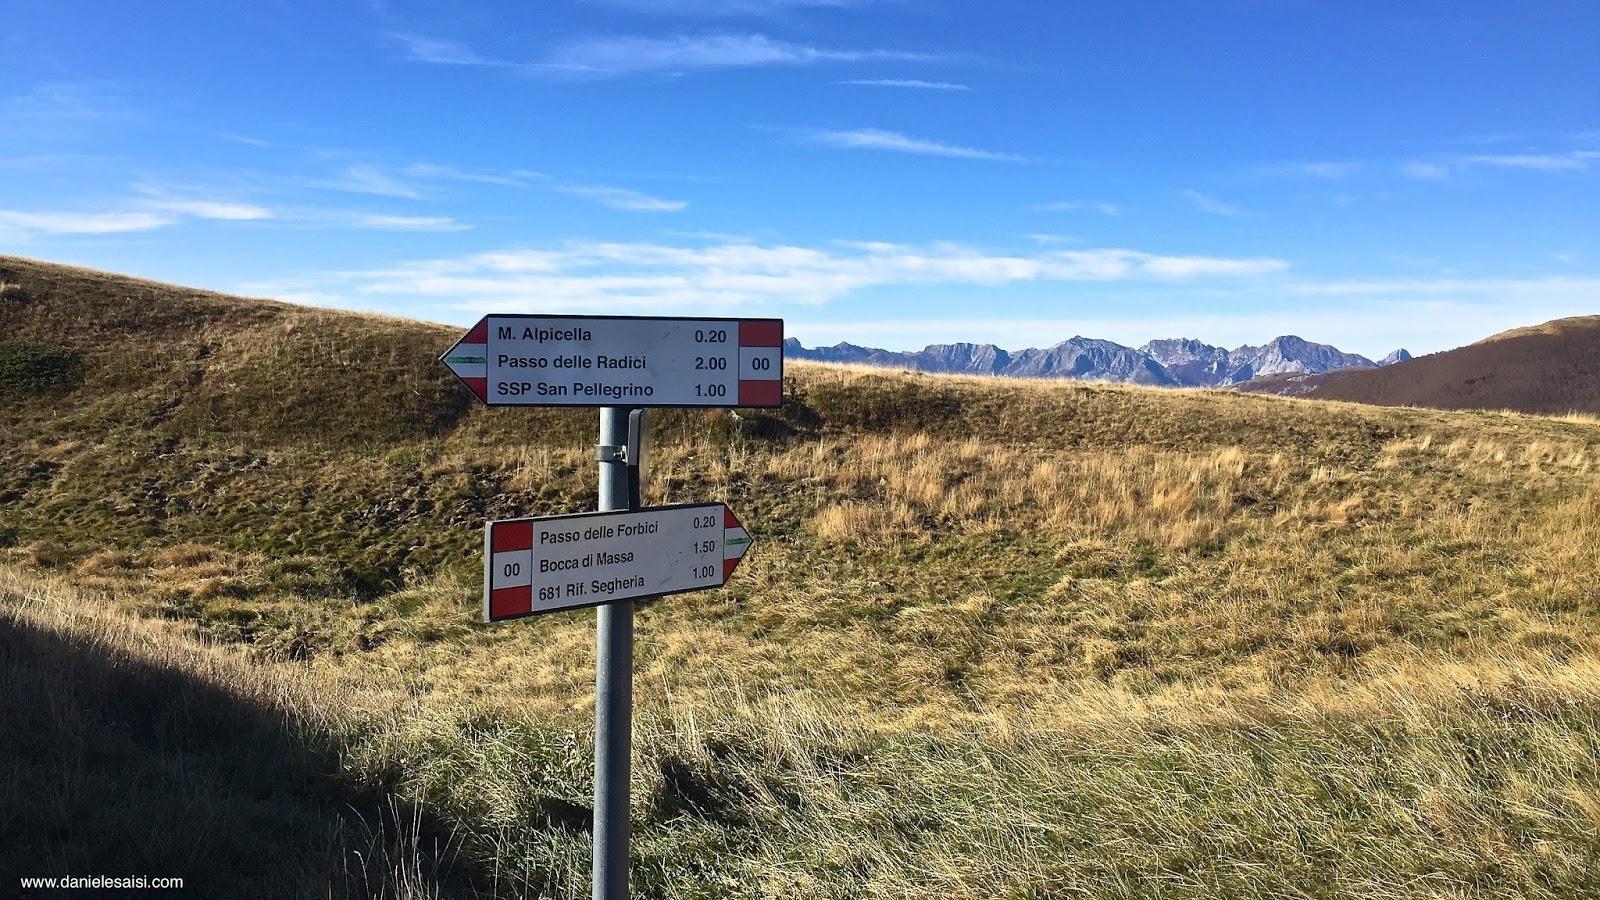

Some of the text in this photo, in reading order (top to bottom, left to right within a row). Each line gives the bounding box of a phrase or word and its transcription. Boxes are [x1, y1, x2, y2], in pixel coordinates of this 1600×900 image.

[498, 327, 727, 344] M. Alpicella 0.20
[498, 355, 727, 370] Passo delle Radici 2.00
[752, 357, 770, 370] 00
[497, 382, 726, 399] SSP San Pellegrino 1.00
[540, 516, 715, 544] Passo delle Forbici 0.20
[540, 541, 715, 573] Bocca di Massa 1.50
[504, 563, 520, 577] 00
[539, 565, 714, 600] 681 Rif. Segheria 1.00
